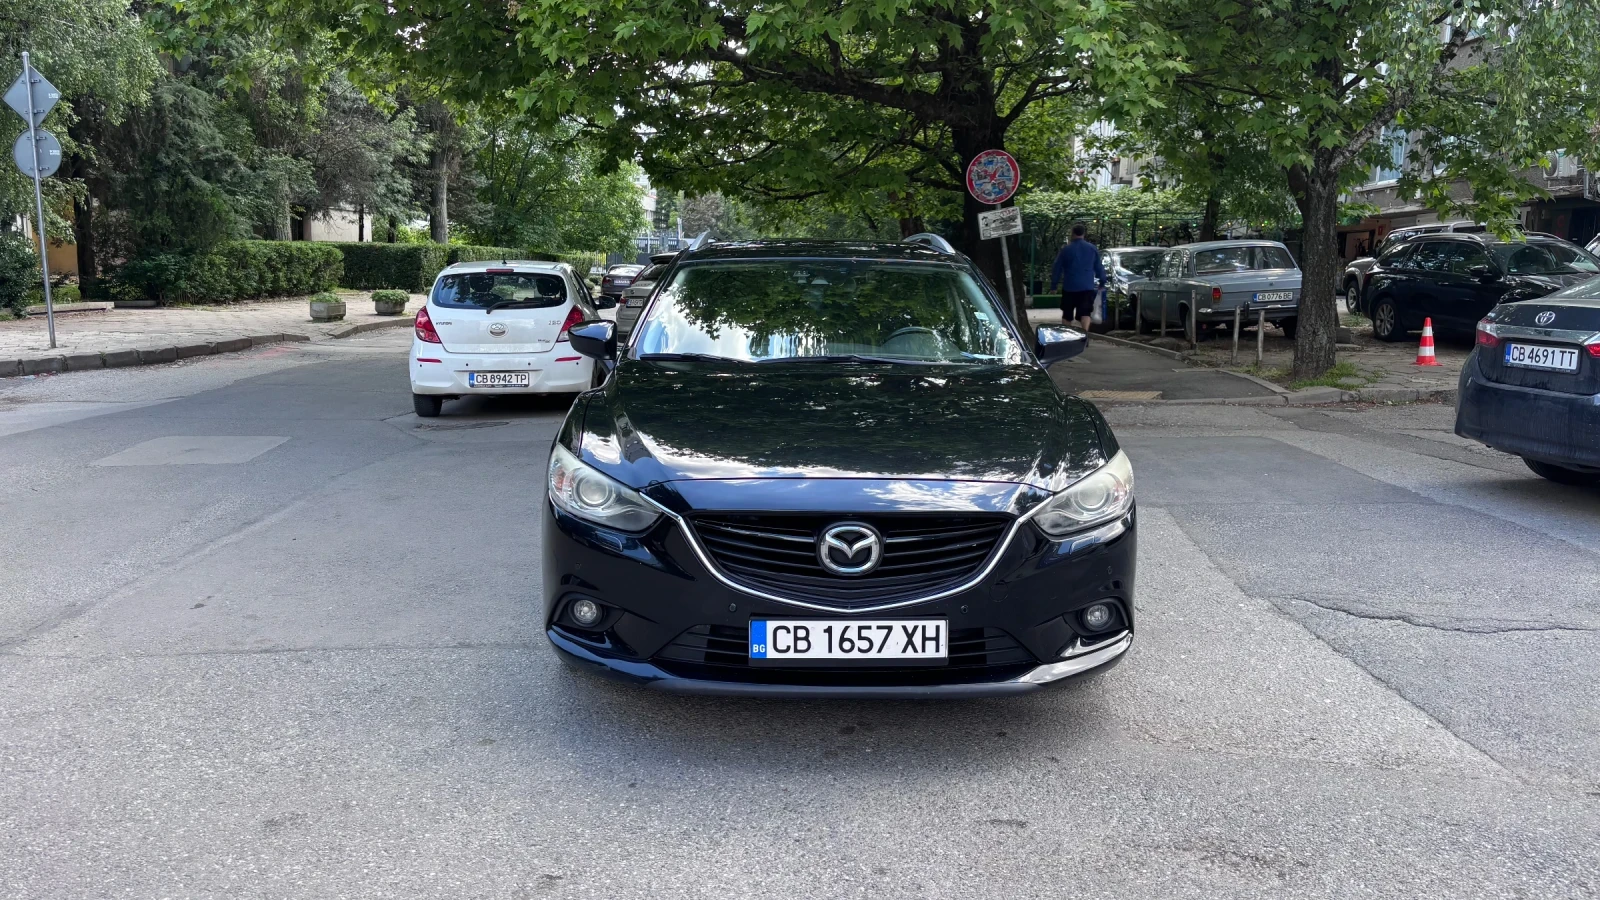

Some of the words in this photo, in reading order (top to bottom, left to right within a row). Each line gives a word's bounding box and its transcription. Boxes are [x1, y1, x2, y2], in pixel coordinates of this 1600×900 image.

[1511, 346, 1526, 362] CB
[1527, 347, 1556, 366] 4691
[1559, 350, 1576, 367] TT
[475, 374, 488, 384] CB
[489, 373, 513, 384] 8942
[514, 374, 527, 384] TP
[772, 625, 812, 654] CB
[823, 625, 894, 654] 1657
[900, 624, 941, 654] XH
[752, 644, 766, 653] BG
